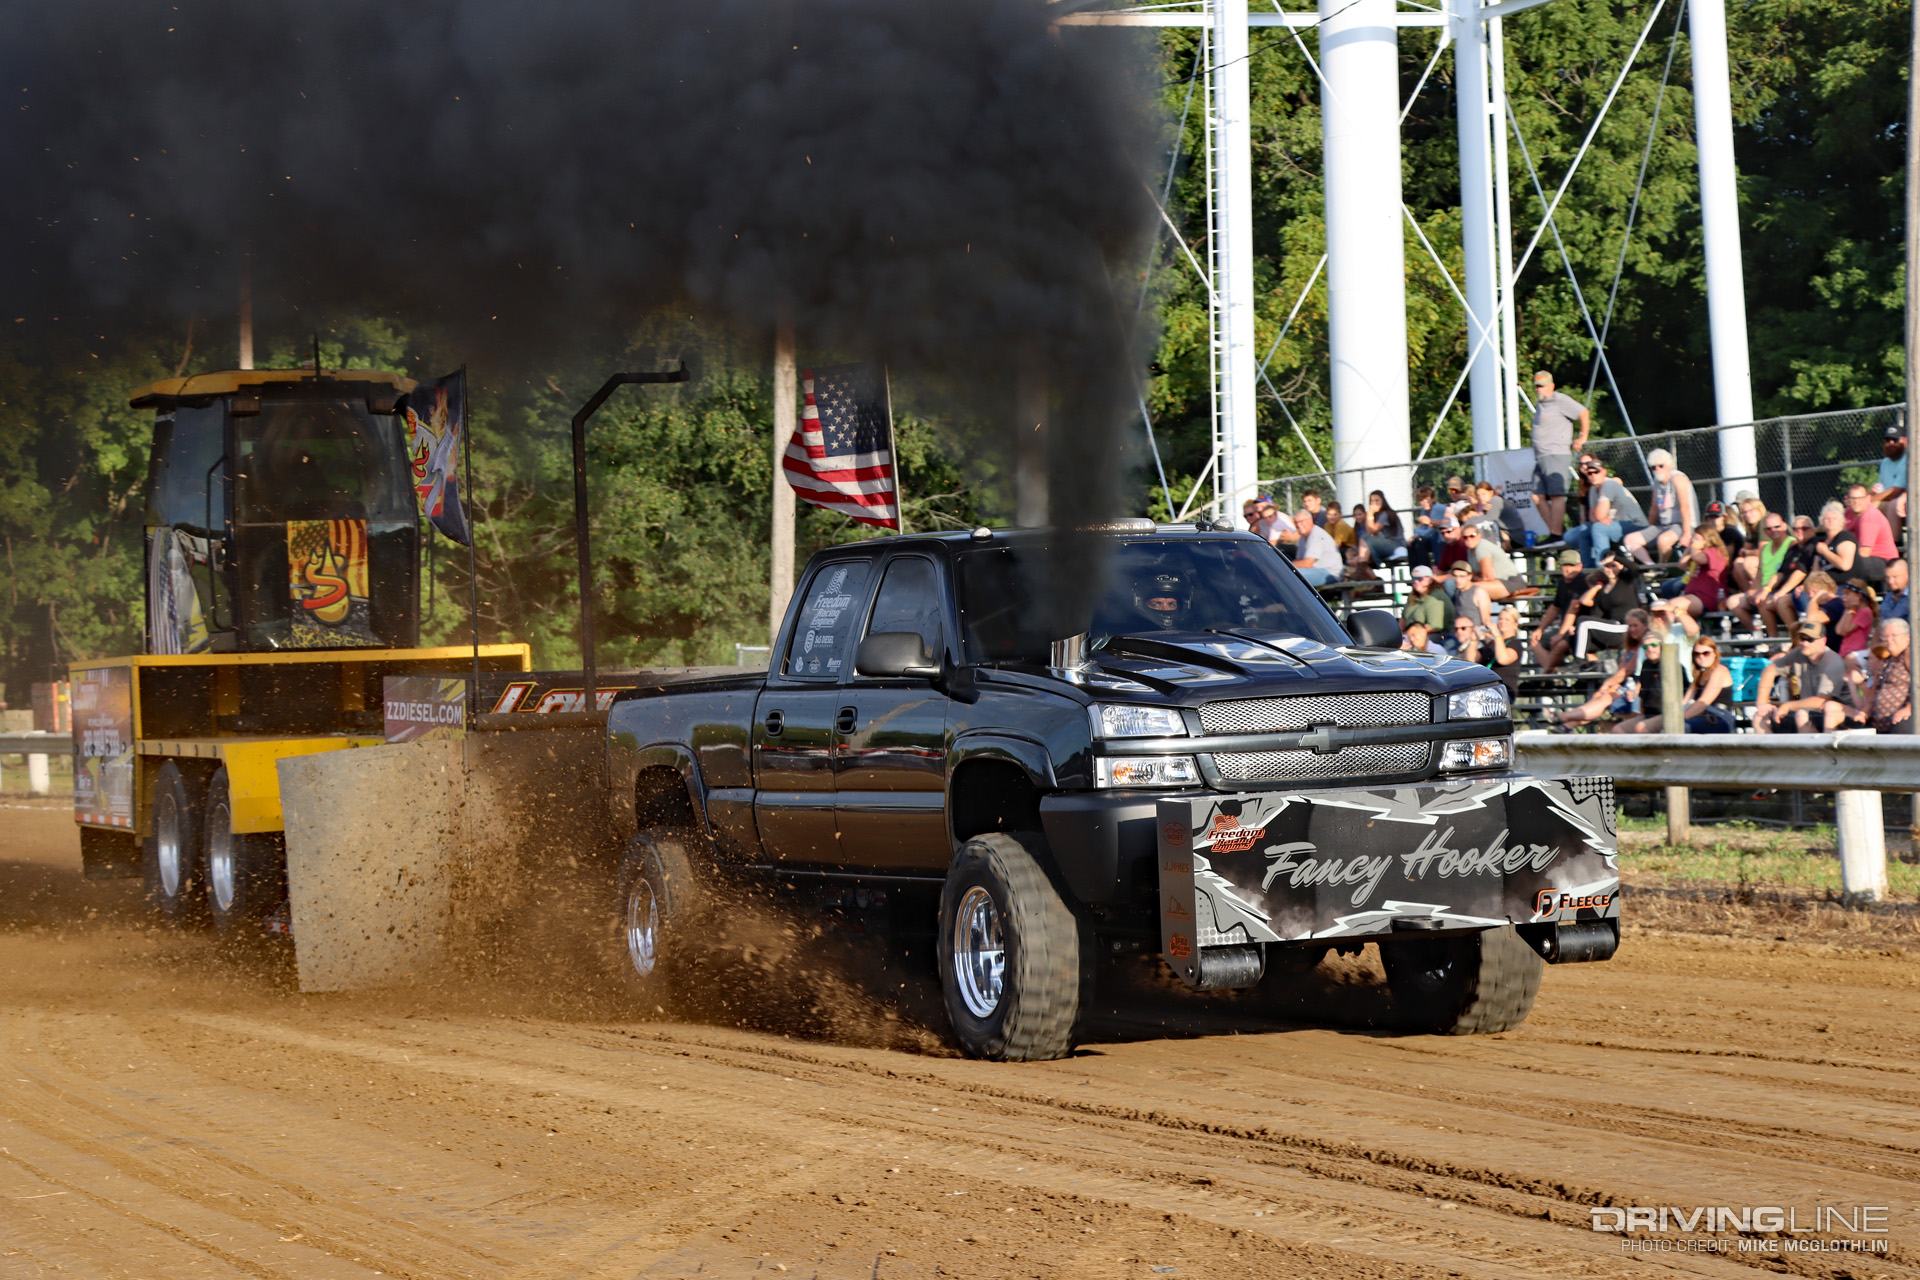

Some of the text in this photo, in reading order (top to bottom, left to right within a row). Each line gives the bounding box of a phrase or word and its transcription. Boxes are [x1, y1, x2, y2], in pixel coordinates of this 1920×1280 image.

[814, 594, 850, 608] Freedom
[817, 608, 840, 619] Racing
[811, 617, 835, 629] Engines
[386, 701, 463, 724] ZZDIESEL.COM
[1209, 828, 1265, 840] Freedom
[1261, 826, 1560, 908] Fancy Hooker
[1559, 893, 1611, 910] FLEECE
